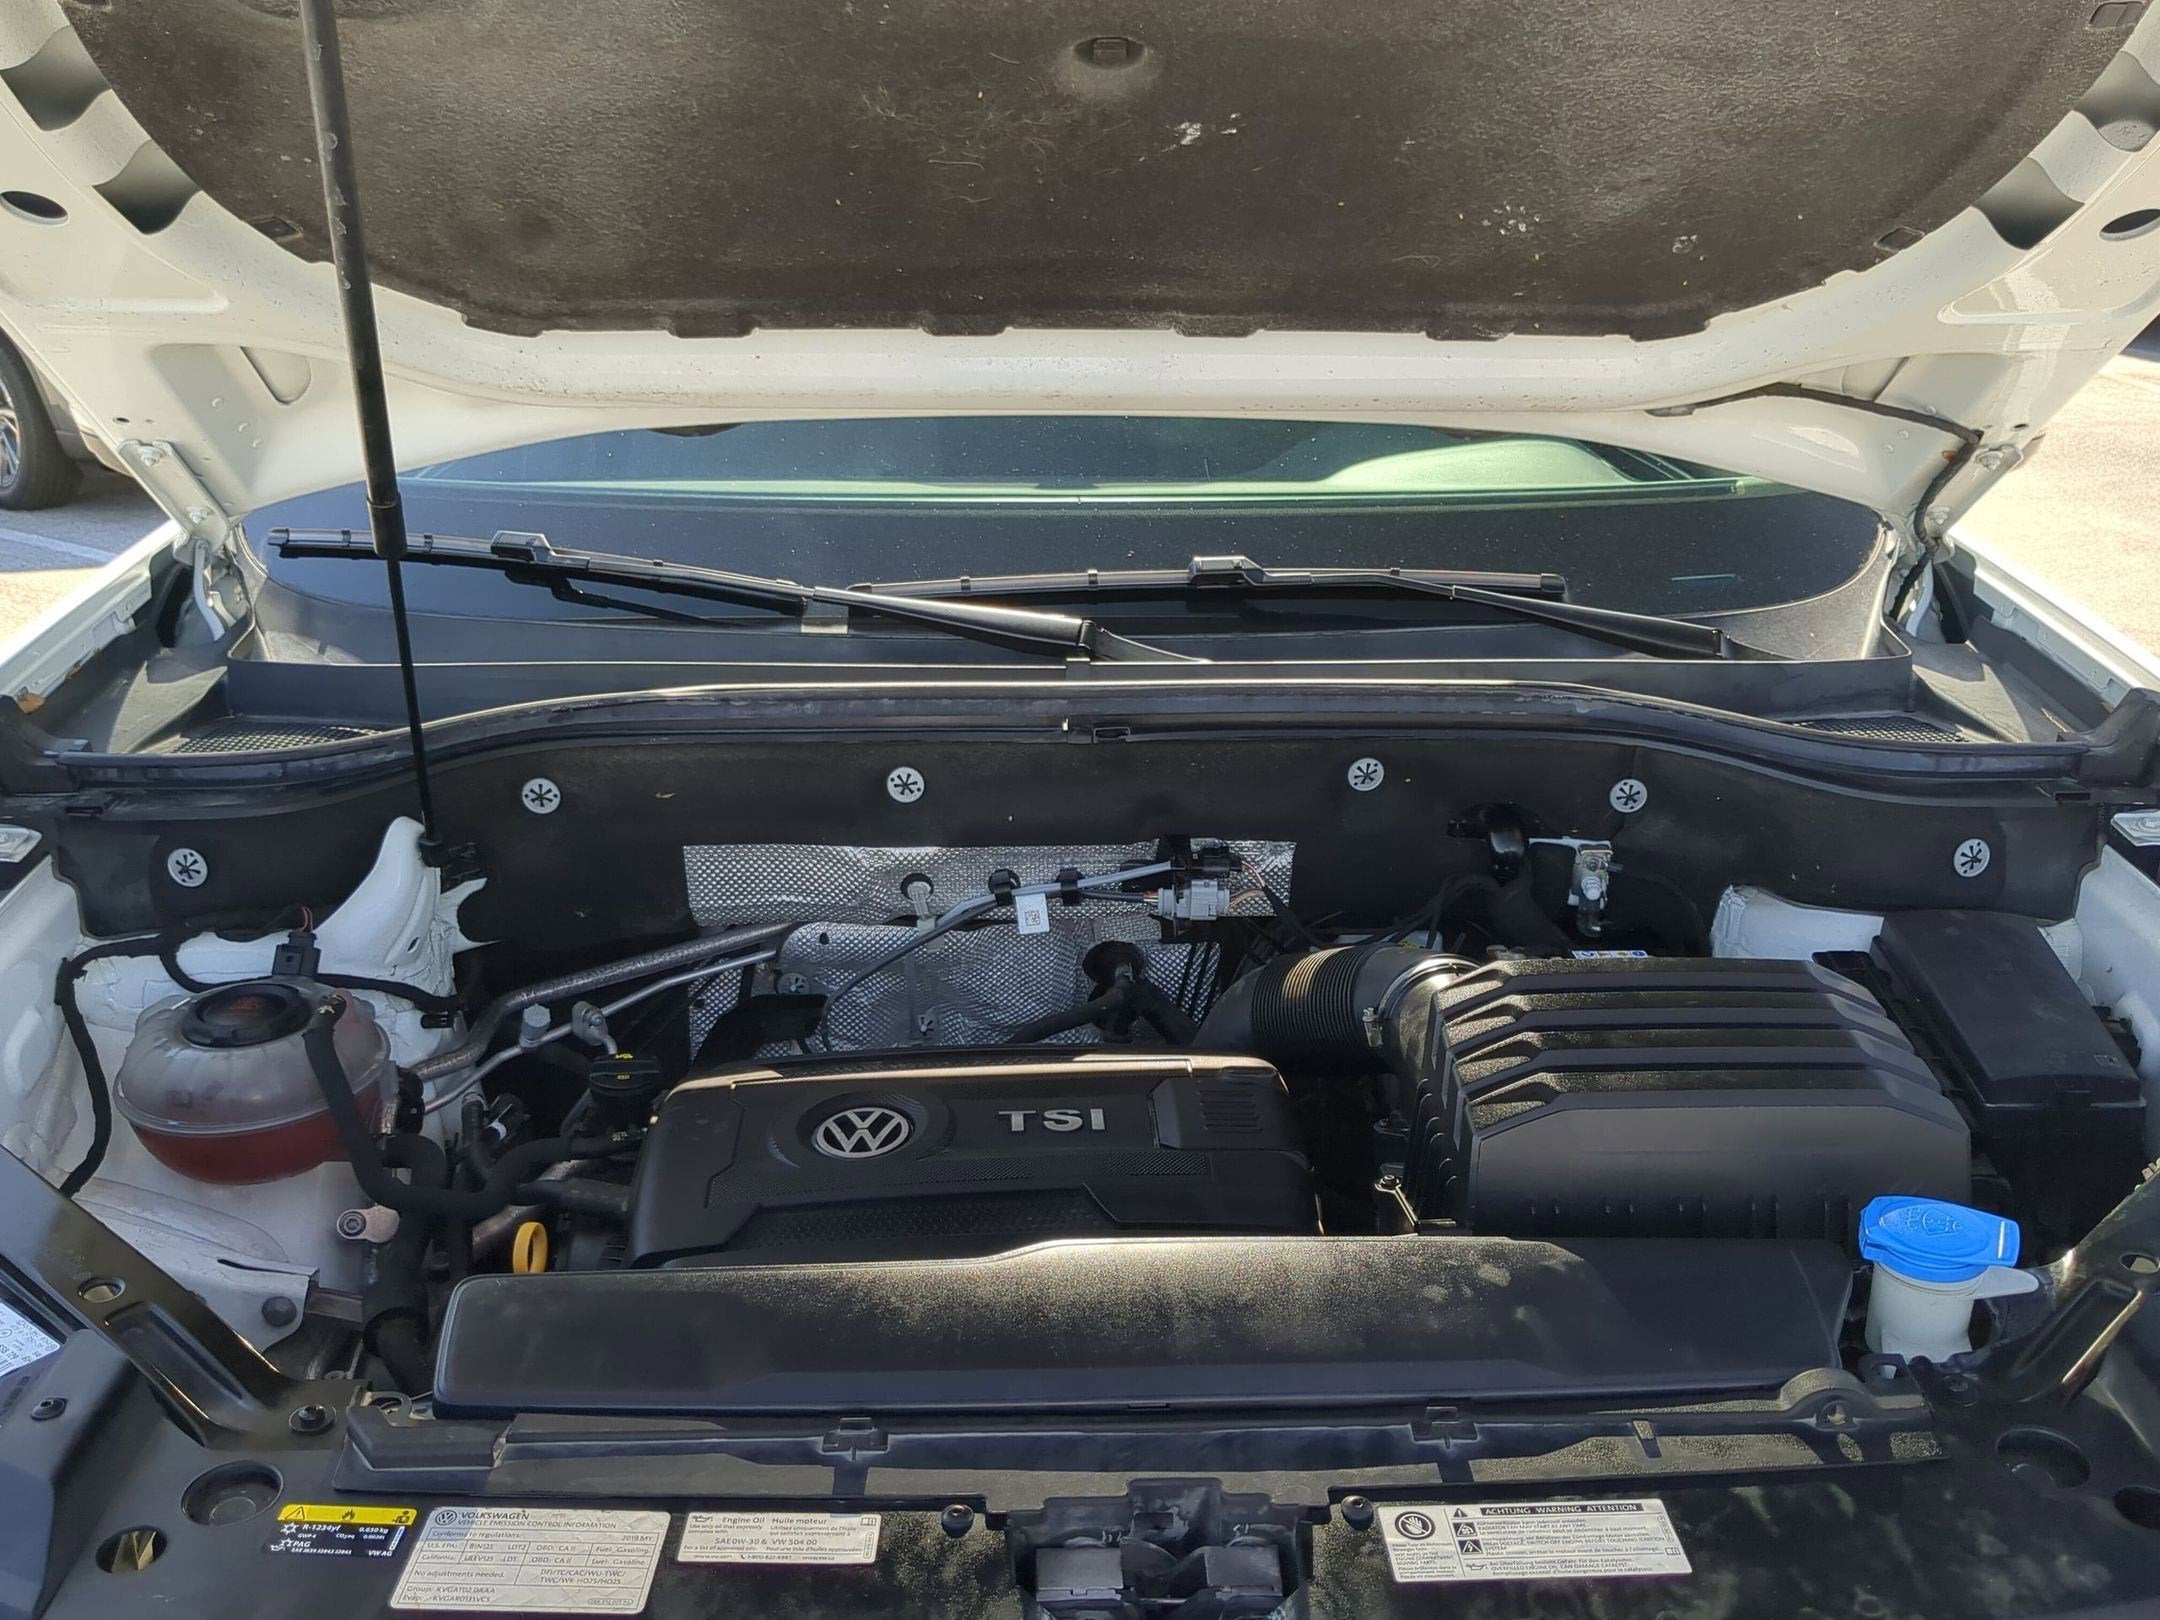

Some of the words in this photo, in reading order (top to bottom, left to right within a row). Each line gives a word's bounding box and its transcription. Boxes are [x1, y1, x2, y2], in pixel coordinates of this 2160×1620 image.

[998, 1108, 1106, 1132] TSI
[1485, 1506, 1531, 1515] ACHTUNG
[1535, 1505, 1582, 1514] WARNING
[1586, 1504, 1637, 1512] ATTENTION
[461, 1511, 530, 1520] VOLKSWAGEN
[489, 1519, 525, 1527] EMISSION
[526, 1520, 562, 1528] CONTROL
[563, 1521, 617, 1529] INFORMATION
[722, 1516, 751, 1525] Engine
[771, 1517, 796, 1525] Huile
[796, 1517, 828, 1525] moteur
[302, 1523, 342, 1533] R-1234yf
[380, 1526, 389, 1535] kg
[292, 1540, 312, 1548] PAG
[714, 1537, 731, 1545] SAE
[806, 1538, 818, 1546] 00
[426, 1570, 474, 1578] adjustments
